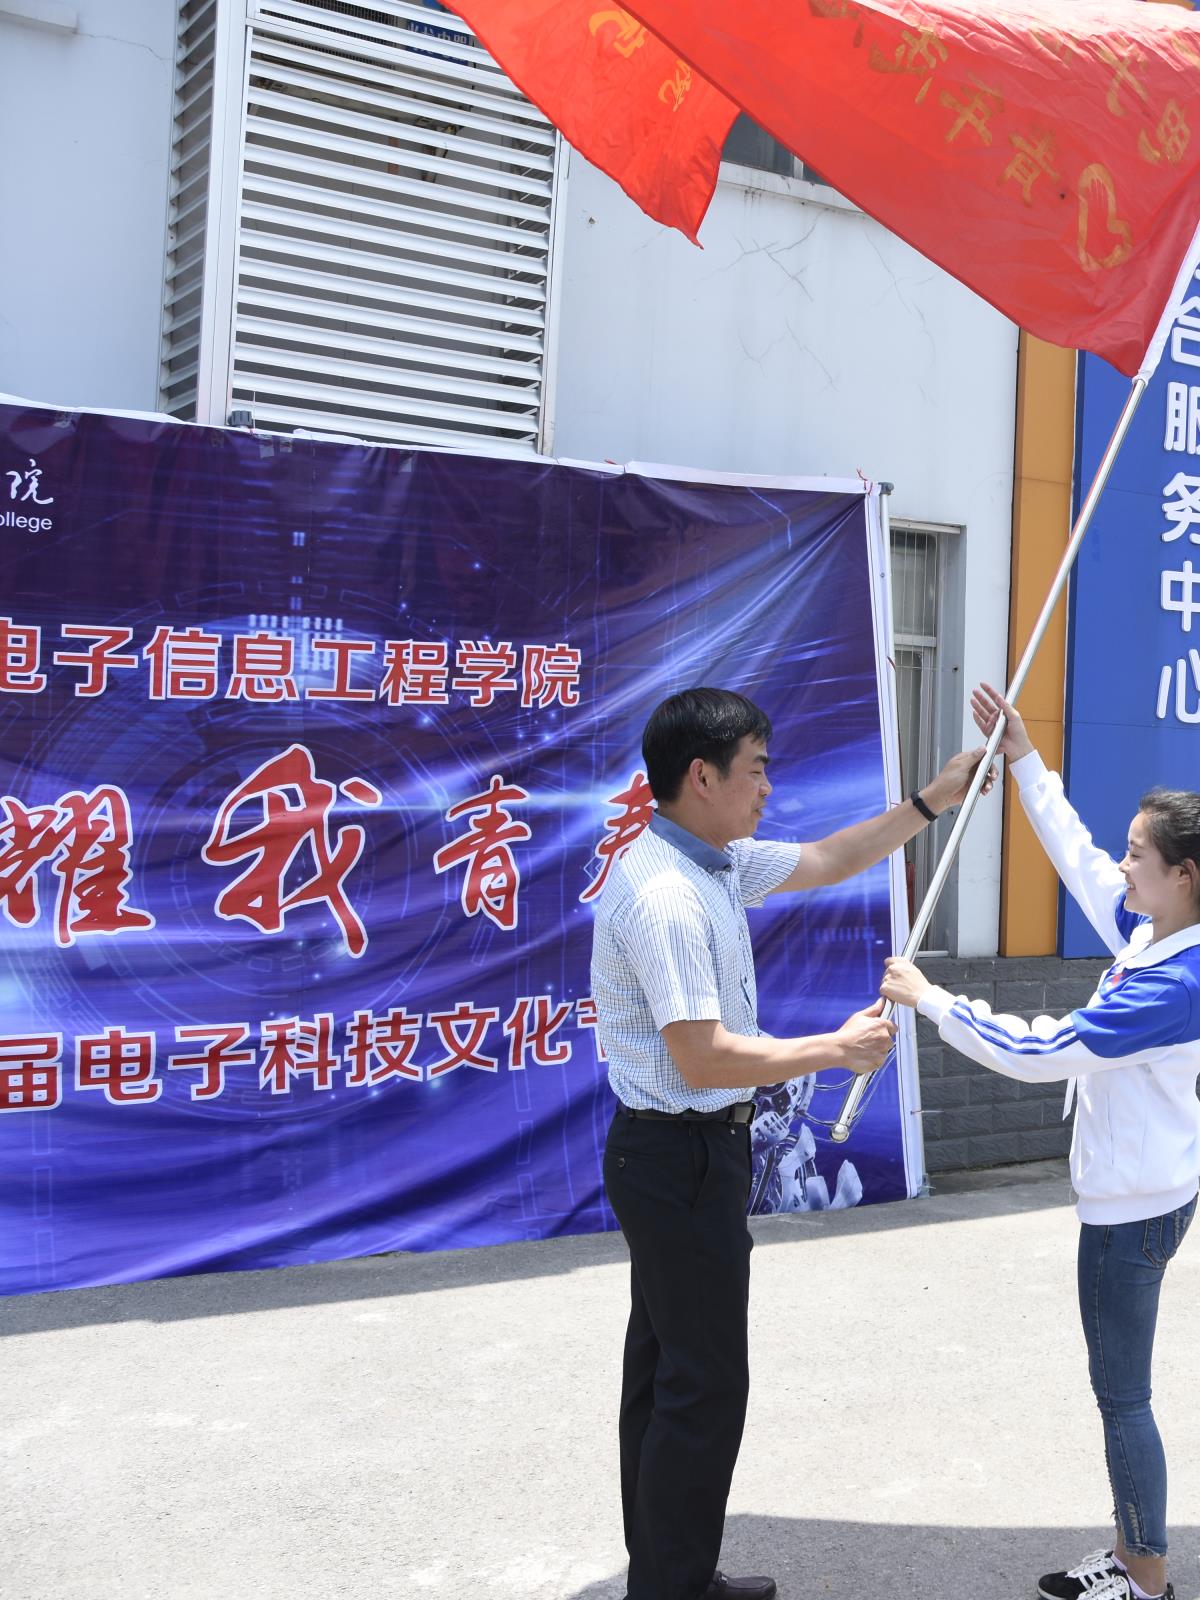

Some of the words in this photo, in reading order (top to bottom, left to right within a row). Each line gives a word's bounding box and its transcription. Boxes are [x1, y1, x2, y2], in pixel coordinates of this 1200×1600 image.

[0, 617, 582, 709] 电子信息工程学院
[0, 994, 609, 1113] 届电子科技文化
